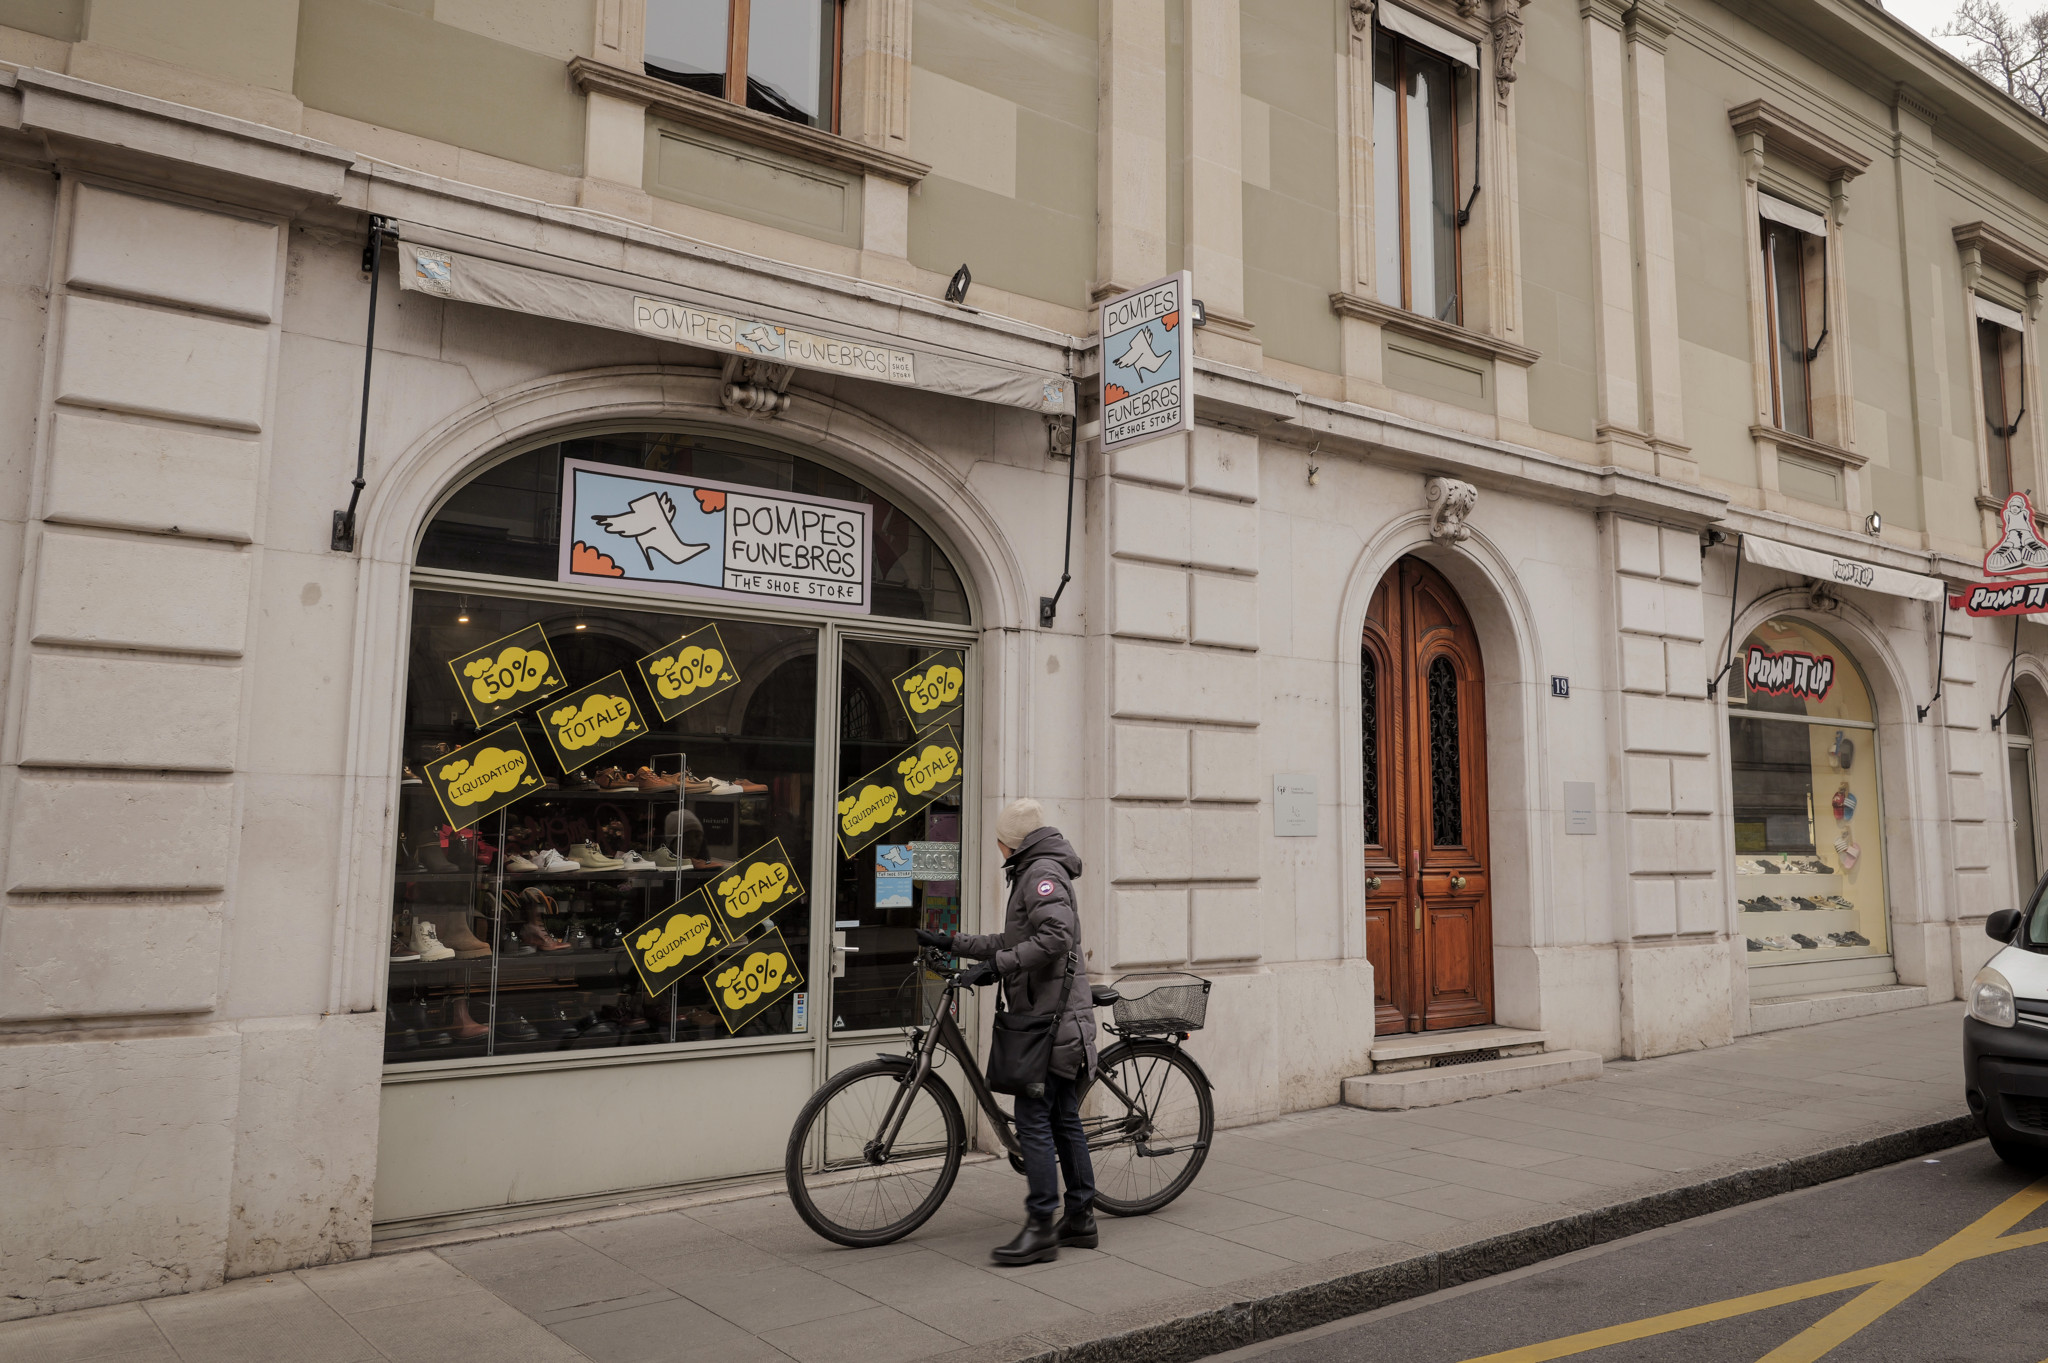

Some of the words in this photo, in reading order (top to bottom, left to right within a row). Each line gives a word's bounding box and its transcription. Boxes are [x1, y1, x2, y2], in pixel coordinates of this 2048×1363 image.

[638, 306, 733, 344] POMPES
[1109, 291, 1174, 332] POMPES
[892, 363, 909, 371] SHOE
[1109, 426, 1124, 441] THE
[1127, 421, 1146, 435] SHOE
[1150, 410, 1177, 428] STORE
[733, 506, 855, 548] POMPES
[731, 573, 762, 590] THE
[766, 578, 800, 594] SHOE
[808, 582, 854, 598] STORE
[1969, 586, 2026, 610] POMP
[483, 655, 537, 695] 50%
[667, 653, 713, 691] 50%
[917, 671, 955, 706] 50%
[1555, 678, 1567, 694] 19
[1747, 650, 1793, 688] POMP
[1809, 660, 1832, 695] UP
[562, 701, 627, 743] TOTALE
[450, 755, 525, 800] LIQUIDATION
[843, 791, 897, 831] LIQUIDATION
[907, 751, 955, 789] TOTALE
[912, 853, 955, 870] CLOSED
[646, 919, 710, 967] LIQUIDATION
[728, 867, 785, 911] TOTALE
[732, 958, 777, 1001] 50%
